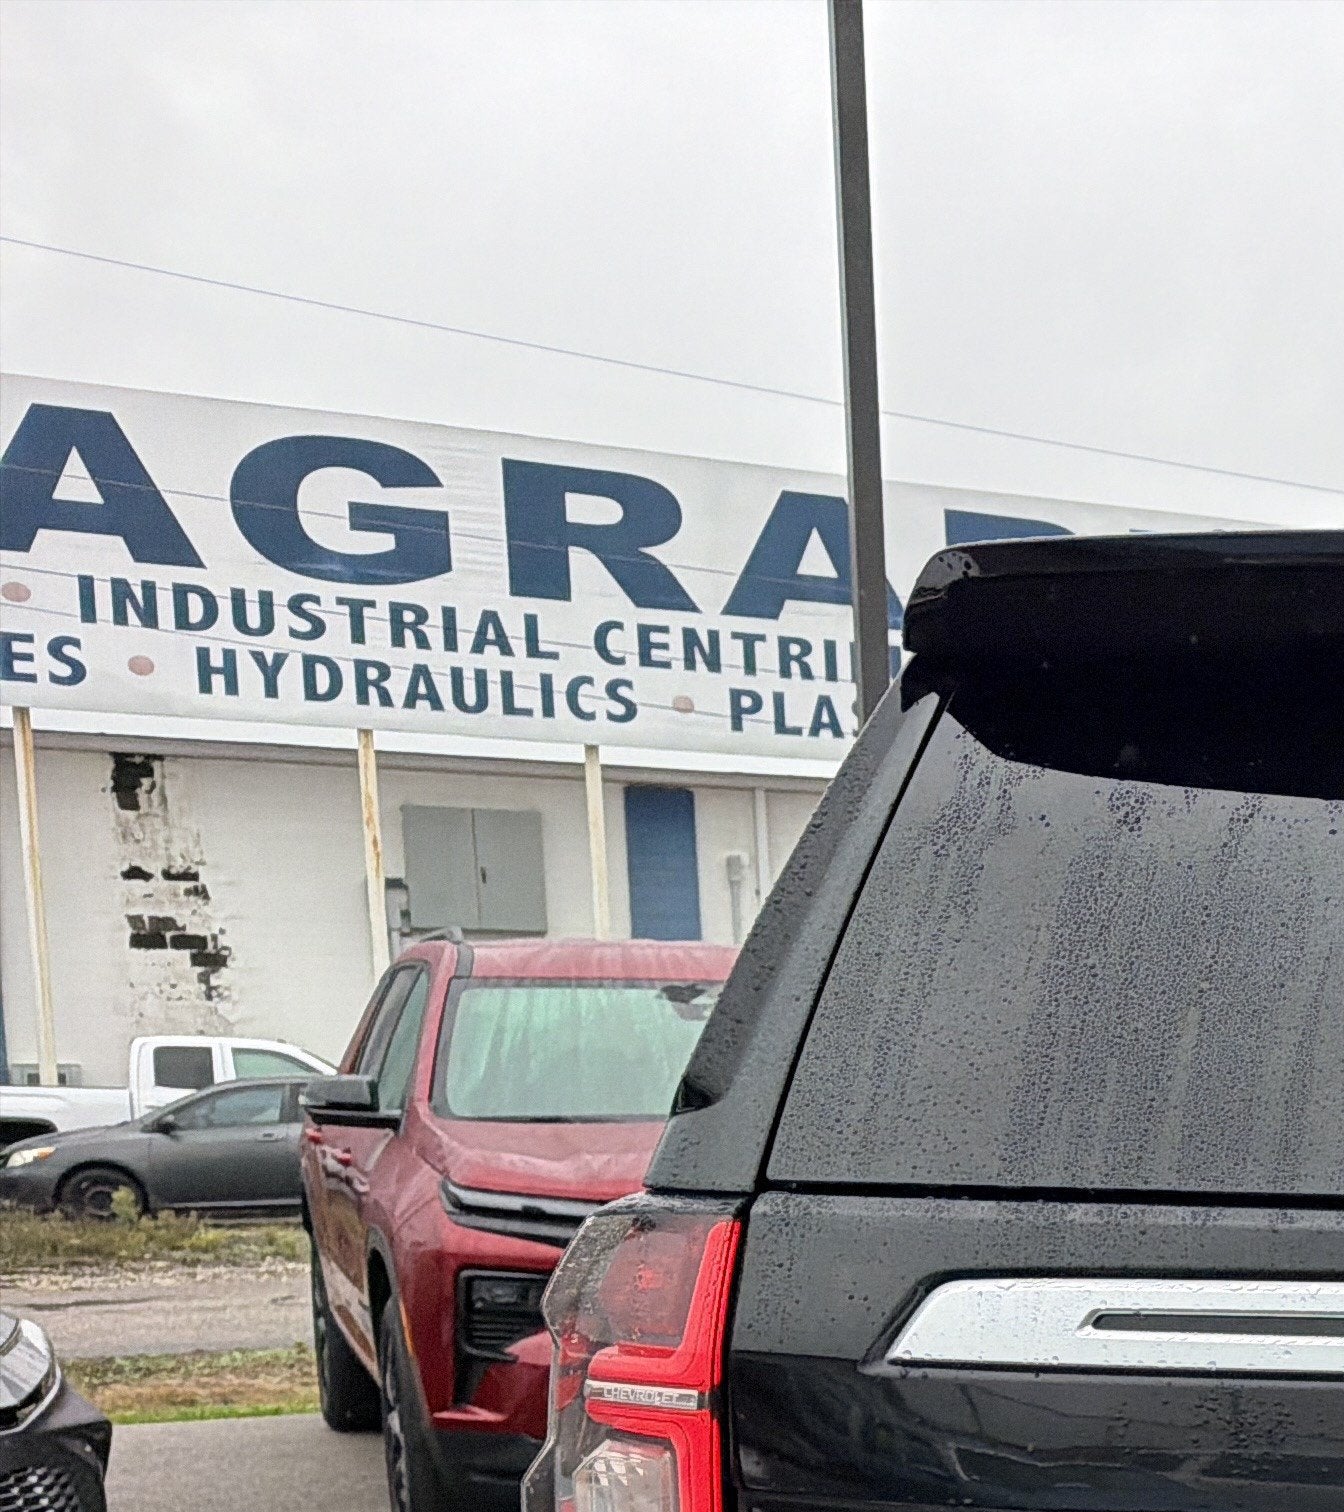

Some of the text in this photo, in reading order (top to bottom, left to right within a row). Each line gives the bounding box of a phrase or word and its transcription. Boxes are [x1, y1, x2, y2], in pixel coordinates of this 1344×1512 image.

[0, 403, 1076, 622] AGRA
[78, 575, 901, 685] INDUSTRIAL CENTRI
[196, 646, 638, 723] HYDRAULICS
[729, 687, 859, 739] PLA
[603, 1386, 680, 1402] CHEVROLET
